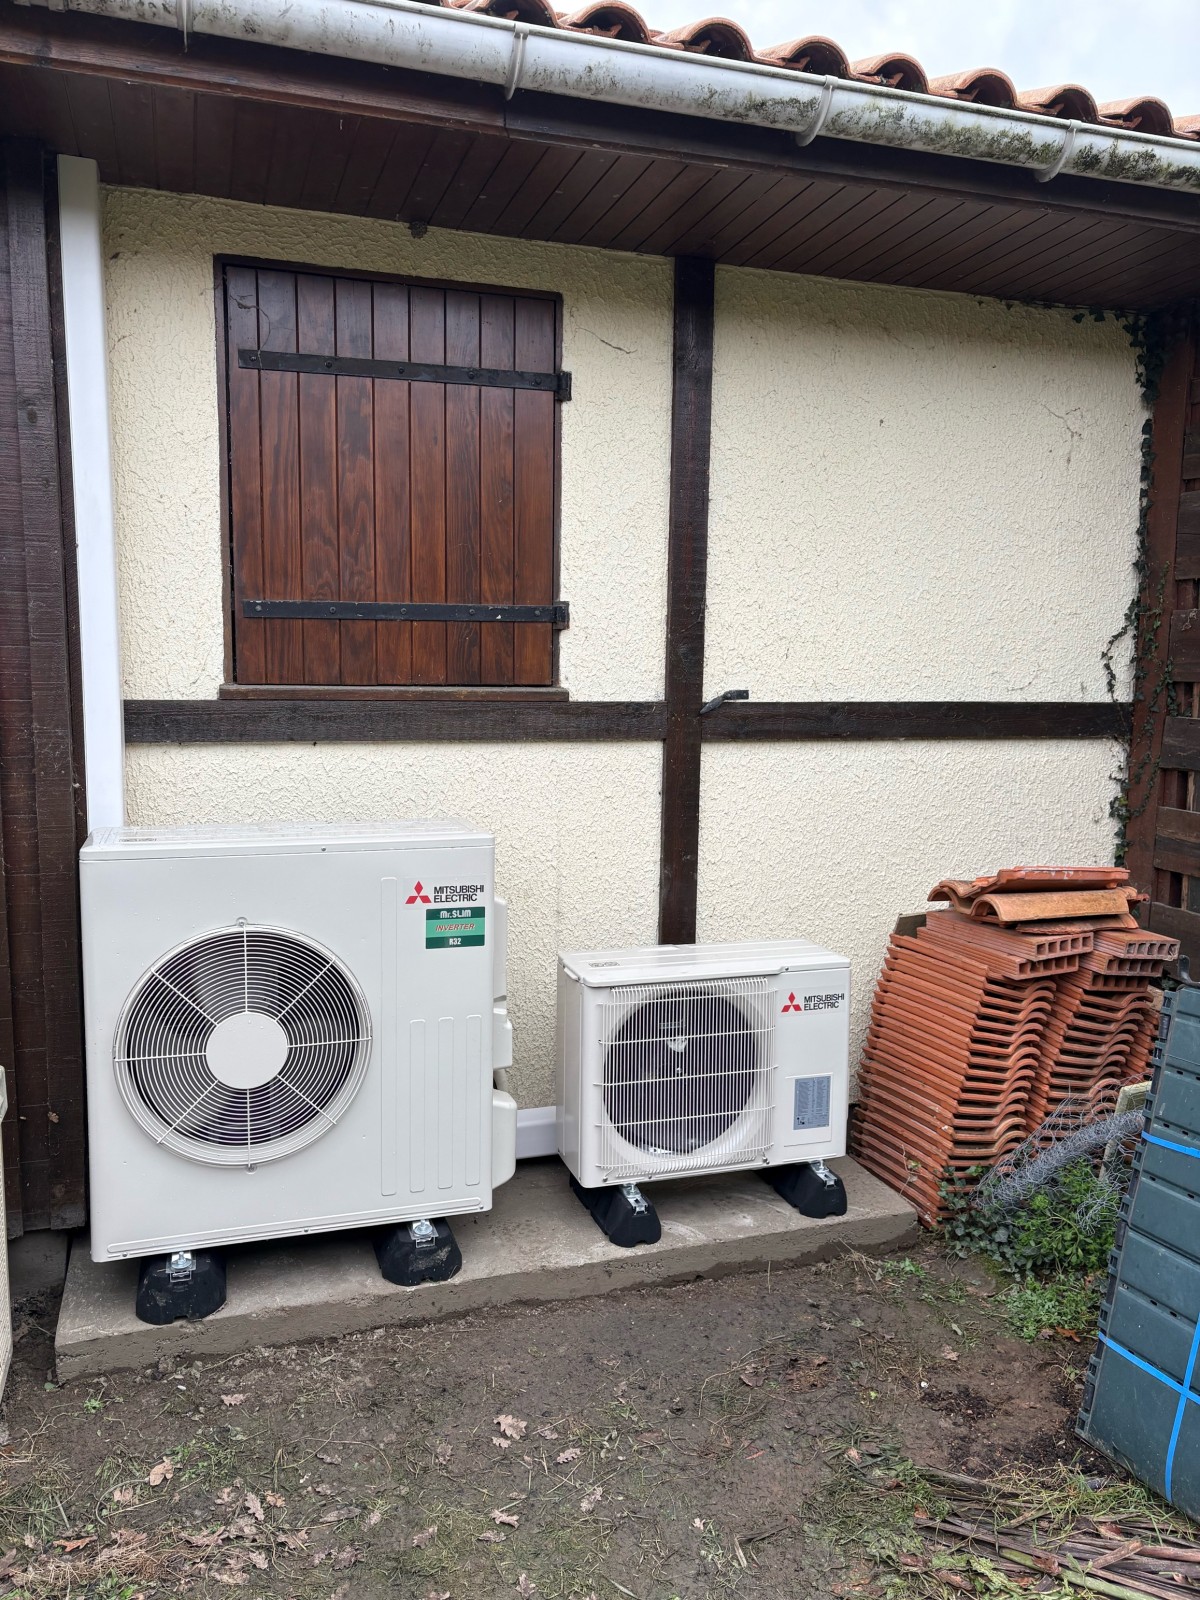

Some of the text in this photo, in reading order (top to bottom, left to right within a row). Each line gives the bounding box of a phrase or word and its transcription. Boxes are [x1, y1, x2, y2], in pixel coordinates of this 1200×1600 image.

[434, 885, 484, 894] MITSUBISHI
[434, 894, 477, 903] ELECTRIC
[435, 923, 475, 931] INVERTER
[804, 993, 845, 1003] MITSUBISHI
[804, 1001, 839, 1011] ELECTRIC
